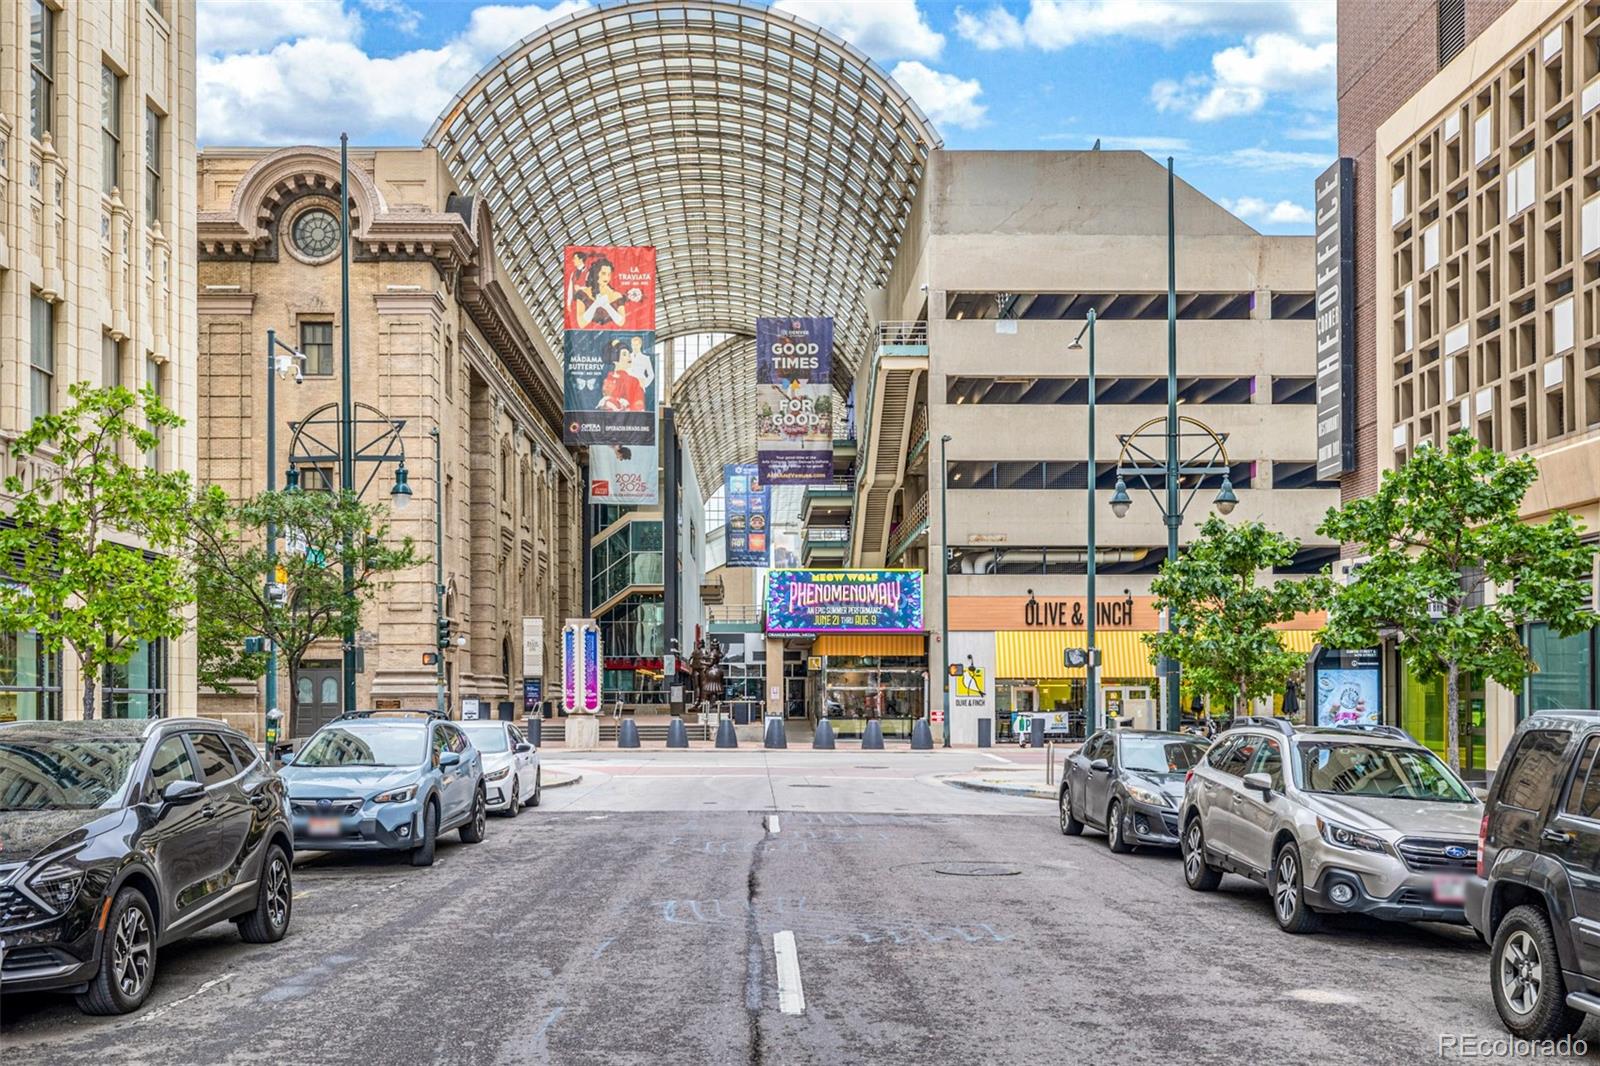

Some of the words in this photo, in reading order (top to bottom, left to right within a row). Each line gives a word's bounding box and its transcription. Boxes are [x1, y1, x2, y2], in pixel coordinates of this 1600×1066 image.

[1317, 172, 1340, 312] OFFICE
[771, 343, 819, 355] GOOD
[771, 357, 819, 369] TIMES
[1318, 328, 1340, 404] THE
[780, 400, 812, 412] FOR
[772, 414, 819, 426] GOOD
[615, 473, 642, 483] 2024
[620, 482, 647, 492] 2025
[812, 573, 844, 582] MEOW
[846, 573, 879, 582] WOLF
[790, 581, 900, 613] PHENOMENOMALY
[807, 606, 815, 614] AN
[815, 606, 826, 614] EPIC
[826, 606, 847, 614] SUMMER
[848, 606, 882, 614] PERFORMANCE
[1025, 602, 1067, 626] OLIVE
[1071, 602, 1084, 626] &
[1096, 602, 1132, 626] INCH
[813, 615, 831, 625] JUNE
[832, 615, 840, 625] 21
[841, 616, 853, 624] THRU
[855, 615, 870, 625] AUG.
[871, 615, 877, 625] 9
[955, 699, 968, 707] OLIVE
[973, 699, 985, 707] FINCH
